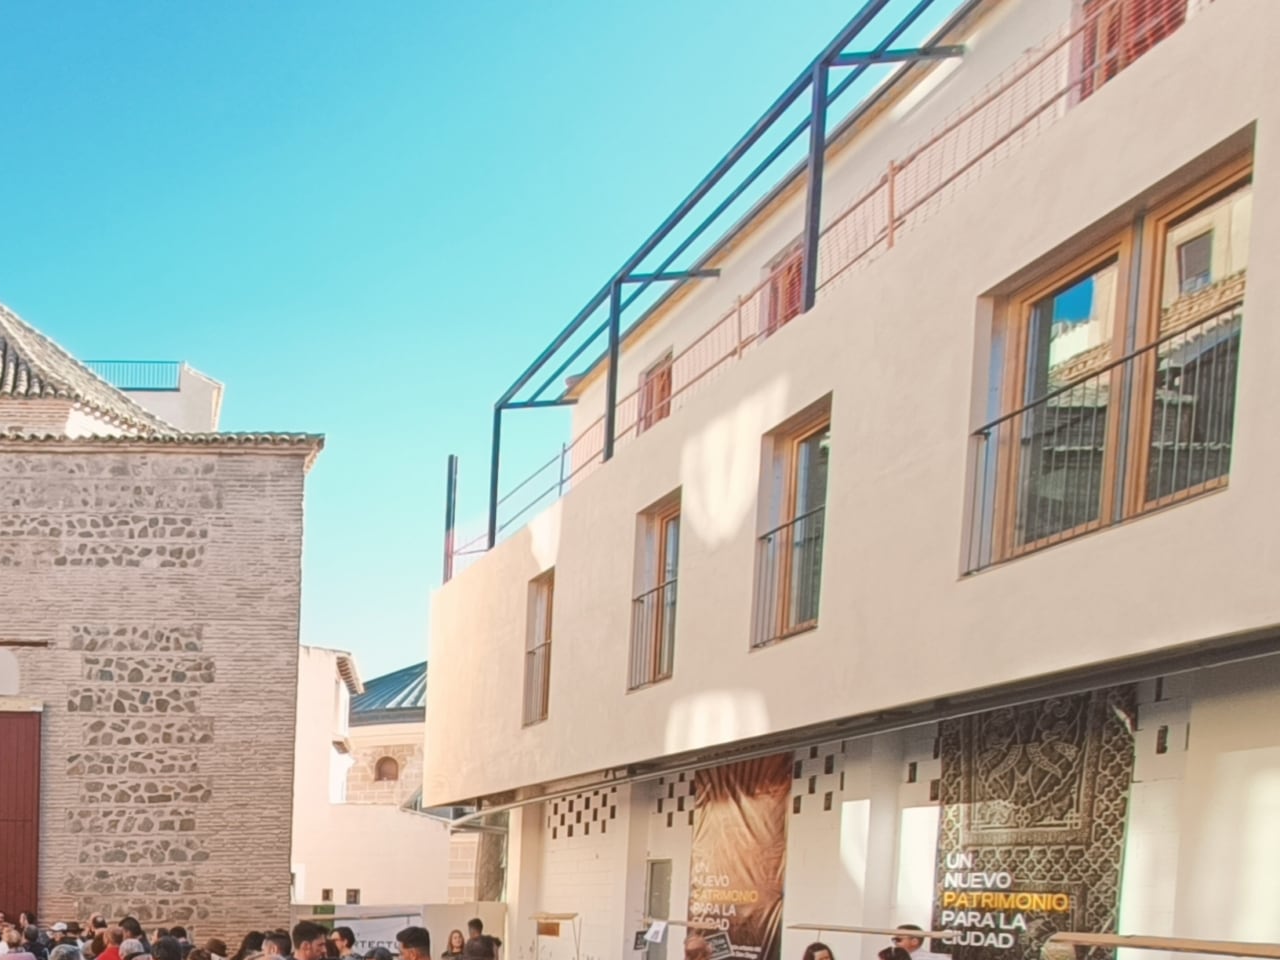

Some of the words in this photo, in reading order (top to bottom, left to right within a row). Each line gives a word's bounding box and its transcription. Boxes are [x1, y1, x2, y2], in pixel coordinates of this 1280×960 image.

[946, 852, 973, 869] UN
[693, 874, 730, 888] NUEVO
[944, 872, 1012, 889] NUEVO
[692, 889, 759, 903] PATRIMONIO
[943, 890, 1069, 911] PATRIMONIO
[691, 902, 720, 916] PARA
[722, 903, 737, 917] LA
[941, 910, 996, 929] PARA
[1000, 912, 1027, 931] LA
[941, 930, 1015, 949] CIUDAD
